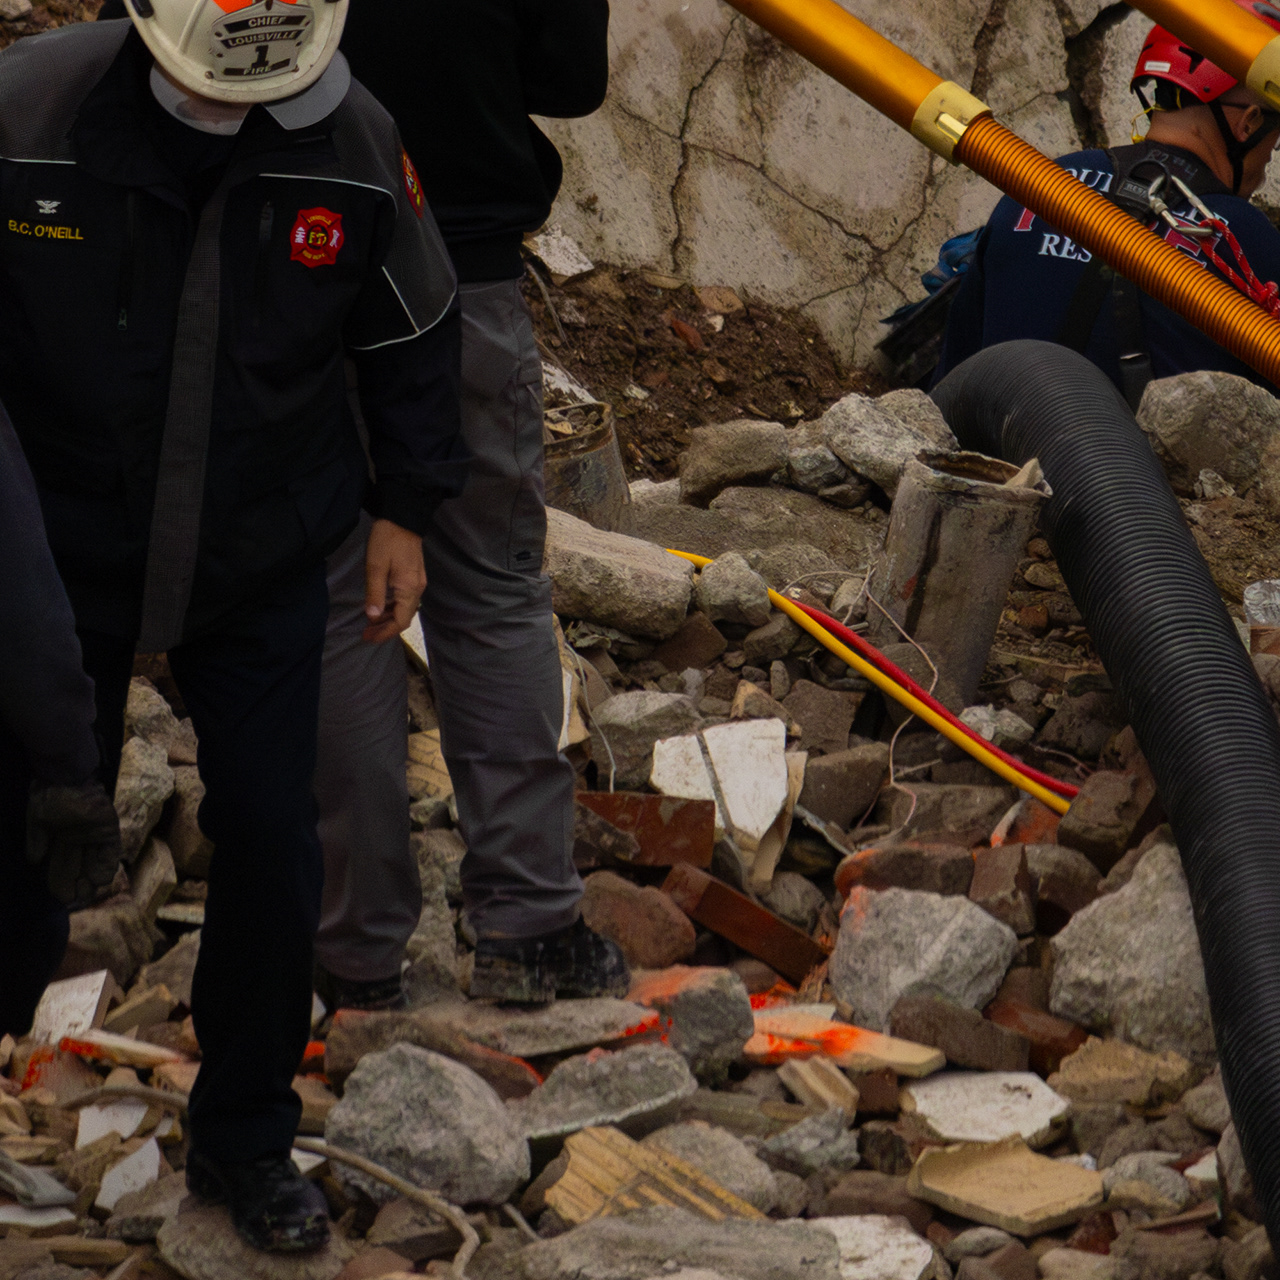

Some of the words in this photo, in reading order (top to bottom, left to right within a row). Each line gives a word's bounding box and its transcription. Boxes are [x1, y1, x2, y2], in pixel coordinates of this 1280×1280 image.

[248, 16, 287, 28] CHIEF
[228, 30, 298, 47] LOUISVILLE
[251, 44, 269, 68] 1
[243, 65, 272, 76] FIRE
[34, 224, 84, 240] O'NEILL
